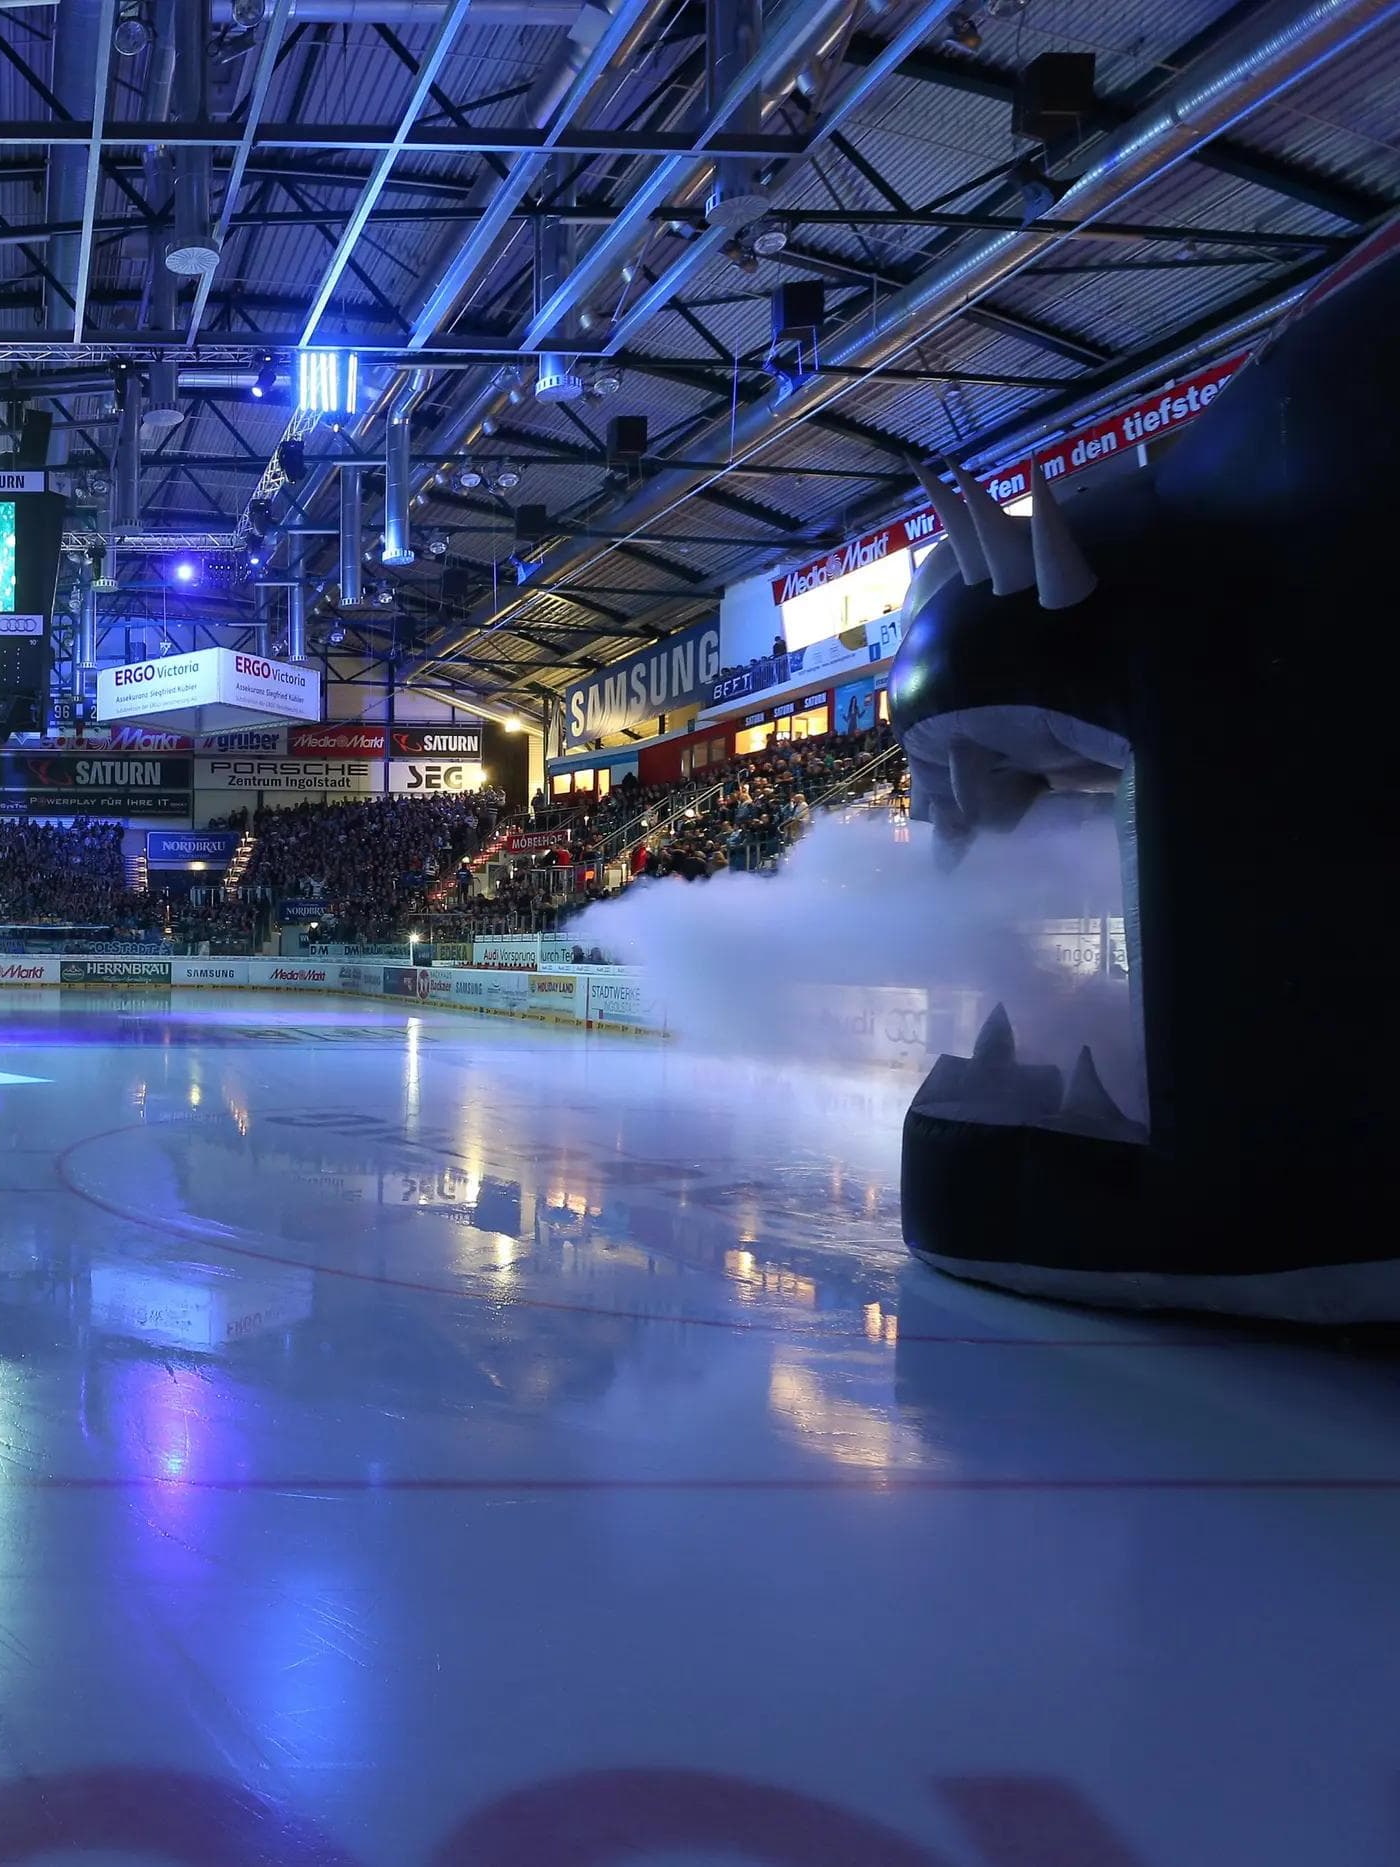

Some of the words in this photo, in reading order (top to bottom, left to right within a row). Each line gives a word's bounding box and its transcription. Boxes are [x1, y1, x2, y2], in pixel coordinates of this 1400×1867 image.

[903, 514, 935, 541] Wir
[1040, 456, 1065, 480] m
[1072, 430, 1117, 467] den
[780, 571, 828, 603] Media
[840, 533, 889, 575] Markt
[115, 664, 155, 686] ERGO
[157, 660, 199, 679] Victoria
[235, 655, 271, 679] ERGO
[271, 668, 306, 687] Victoria
[571, 630, 719, 737] SAMSUNG
[804, 692, 827, 708] SATURN
[773, 703, 795, 718] SATURN
[217, 731, 280, 752] gruber
[294, 734, 337, 748] Media
[346, 734, 384, 749] Markt
[423, 734, 479, 752] SATURN
[75, 760, 161, 786] SATURN
[211, 762, 369, 776] PORSCHE
[228, 775, 282, 787] Zentrum
[286, 775, 351, 789] Ingolstadt
[162, 840, 226, 853] NORDBRÄU
[484, 949, 499, 961] Audi
[500, 950, 536, 963] Vorsprung
[542, 950, 560, 961] urch
[2, 964, 45, 979] Markt
[87, 962, 169, 976] HERRNBRÄU
[187, 969, 235, 978] SAMSUNG
[270, 968, 300, 982] Media
[455, 981, 483, 995] SAMSUNG
[559, 983, 574, 994] LAND
[592, 985, 641, 1001] STADTWERKE
